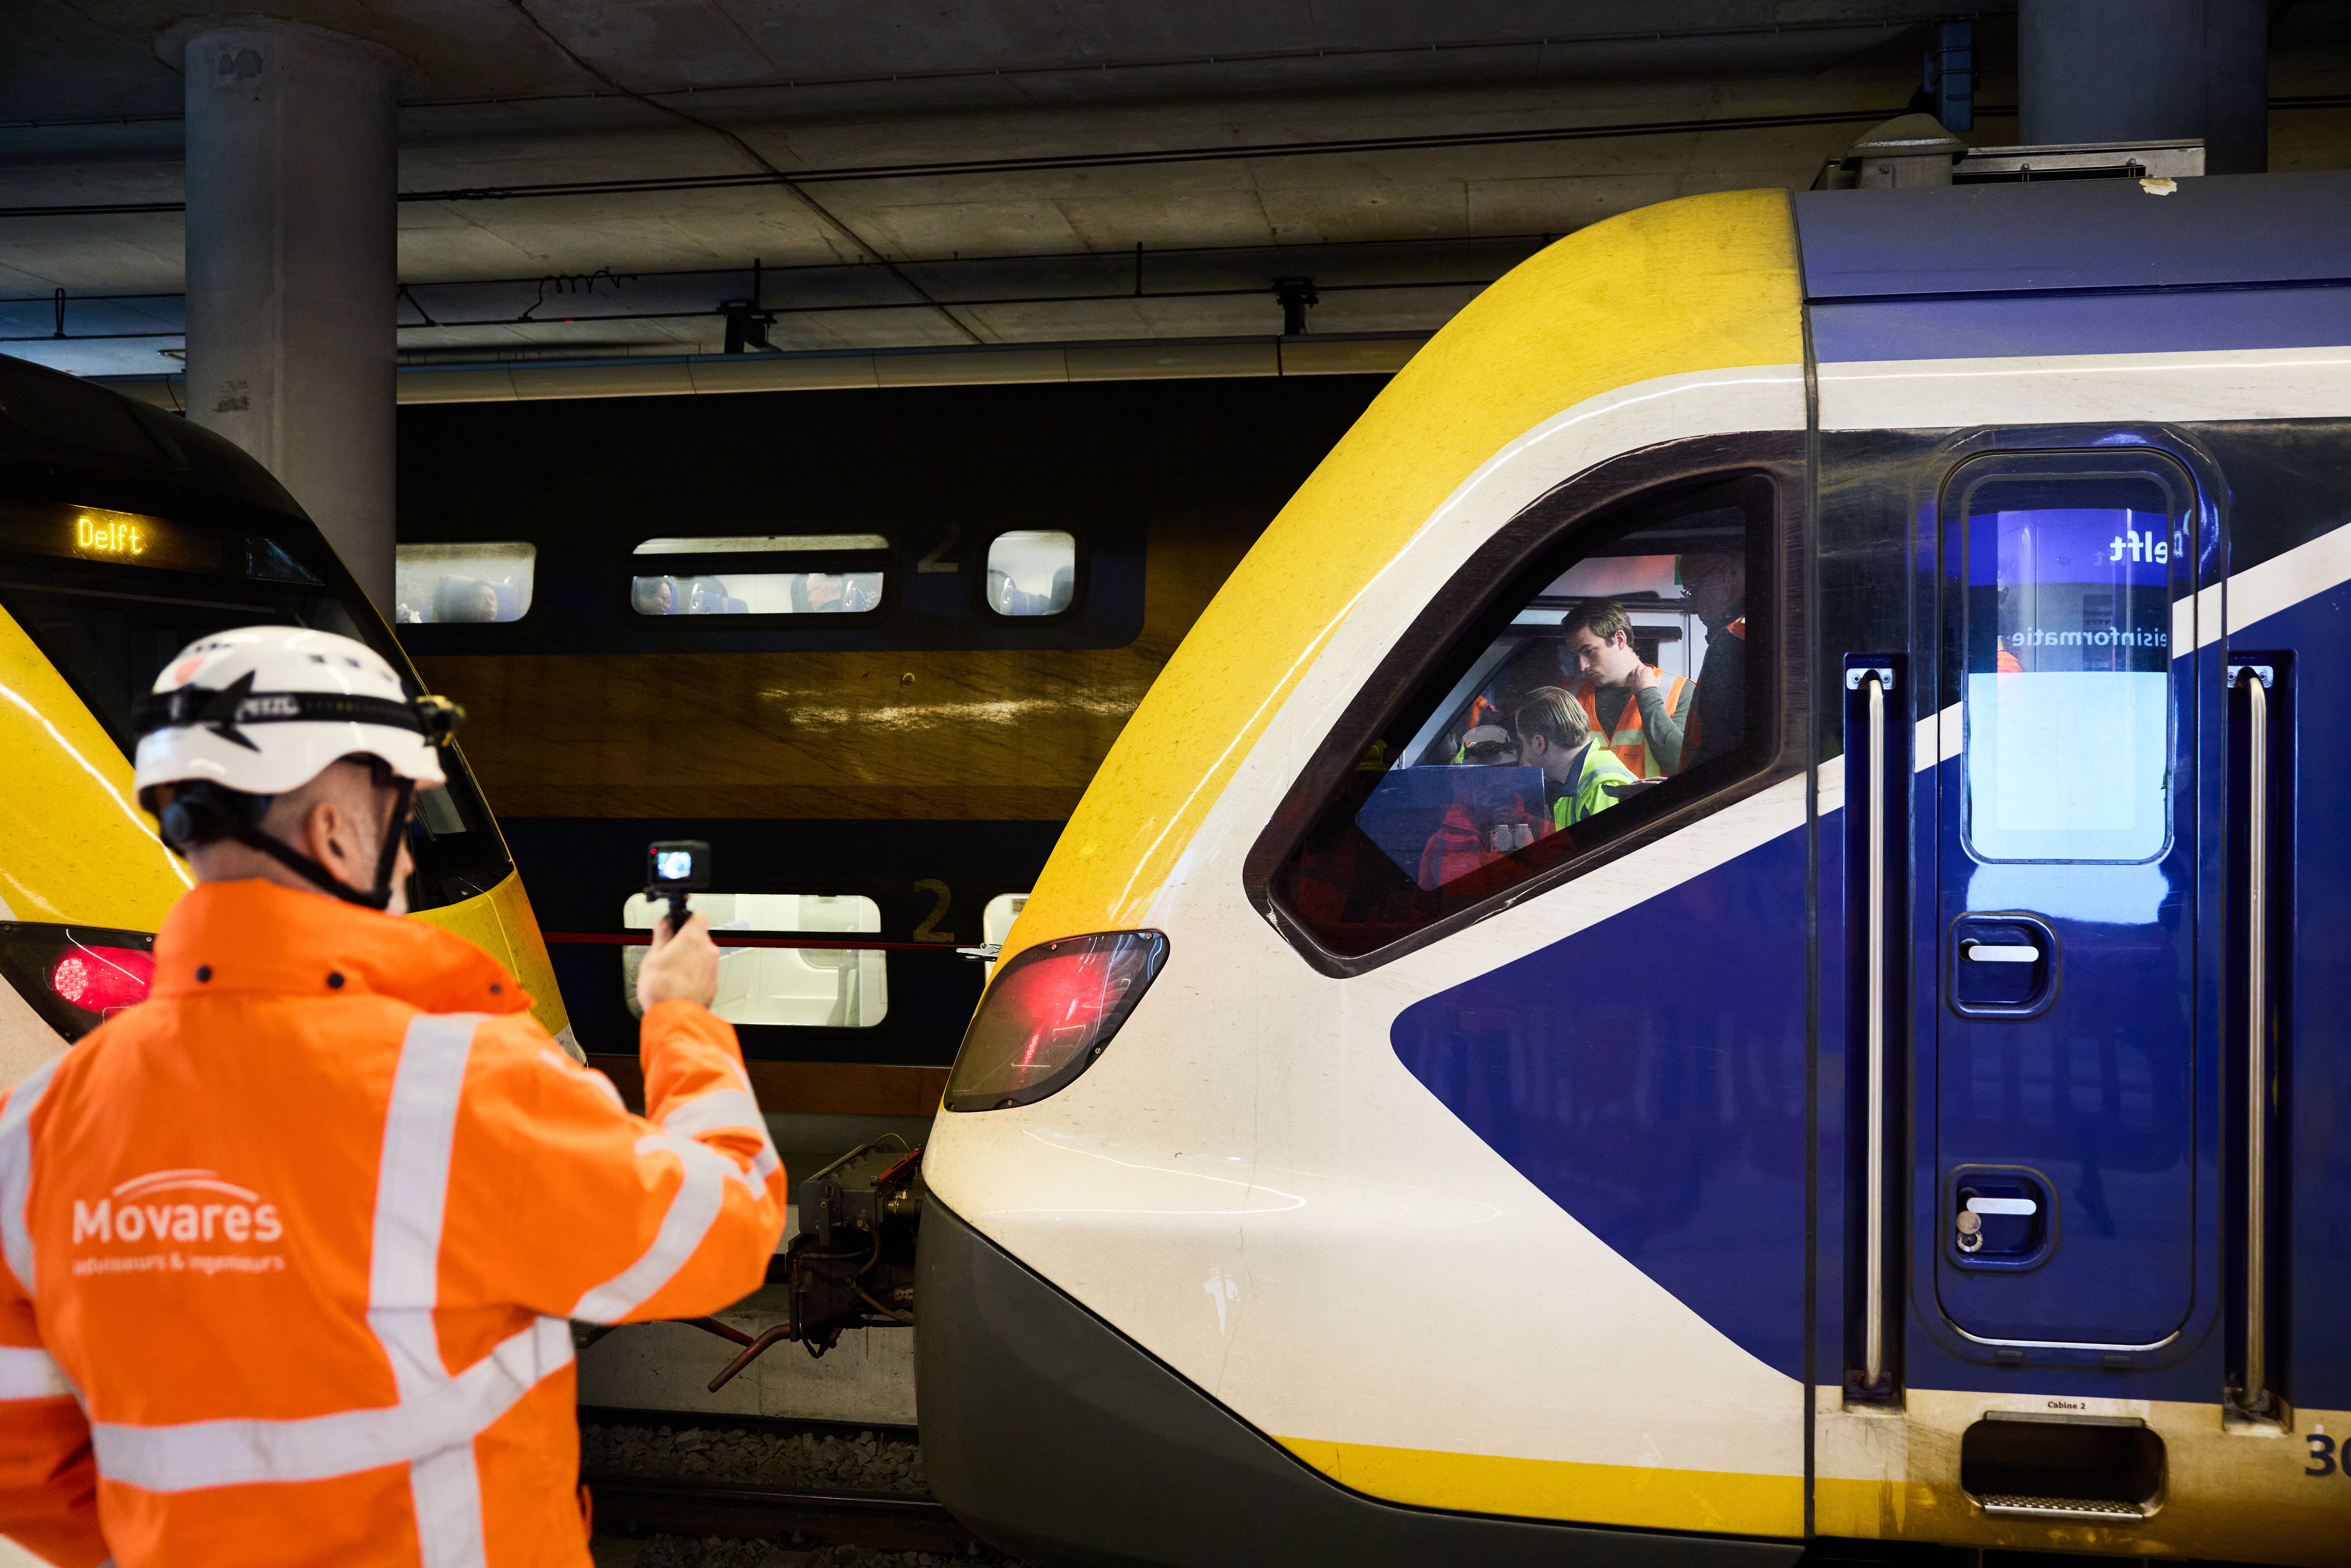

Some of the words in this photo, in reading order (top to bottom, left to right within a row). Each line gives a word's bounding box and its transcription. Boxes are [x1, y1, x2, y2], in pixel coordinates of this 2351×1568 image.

[78, 517, 142, 554] Delft
[913, 878, 955, 942] 2
[73, 1198, 283, 1245] Movares
[2048, 1401, 2078, 1409] Cabine
